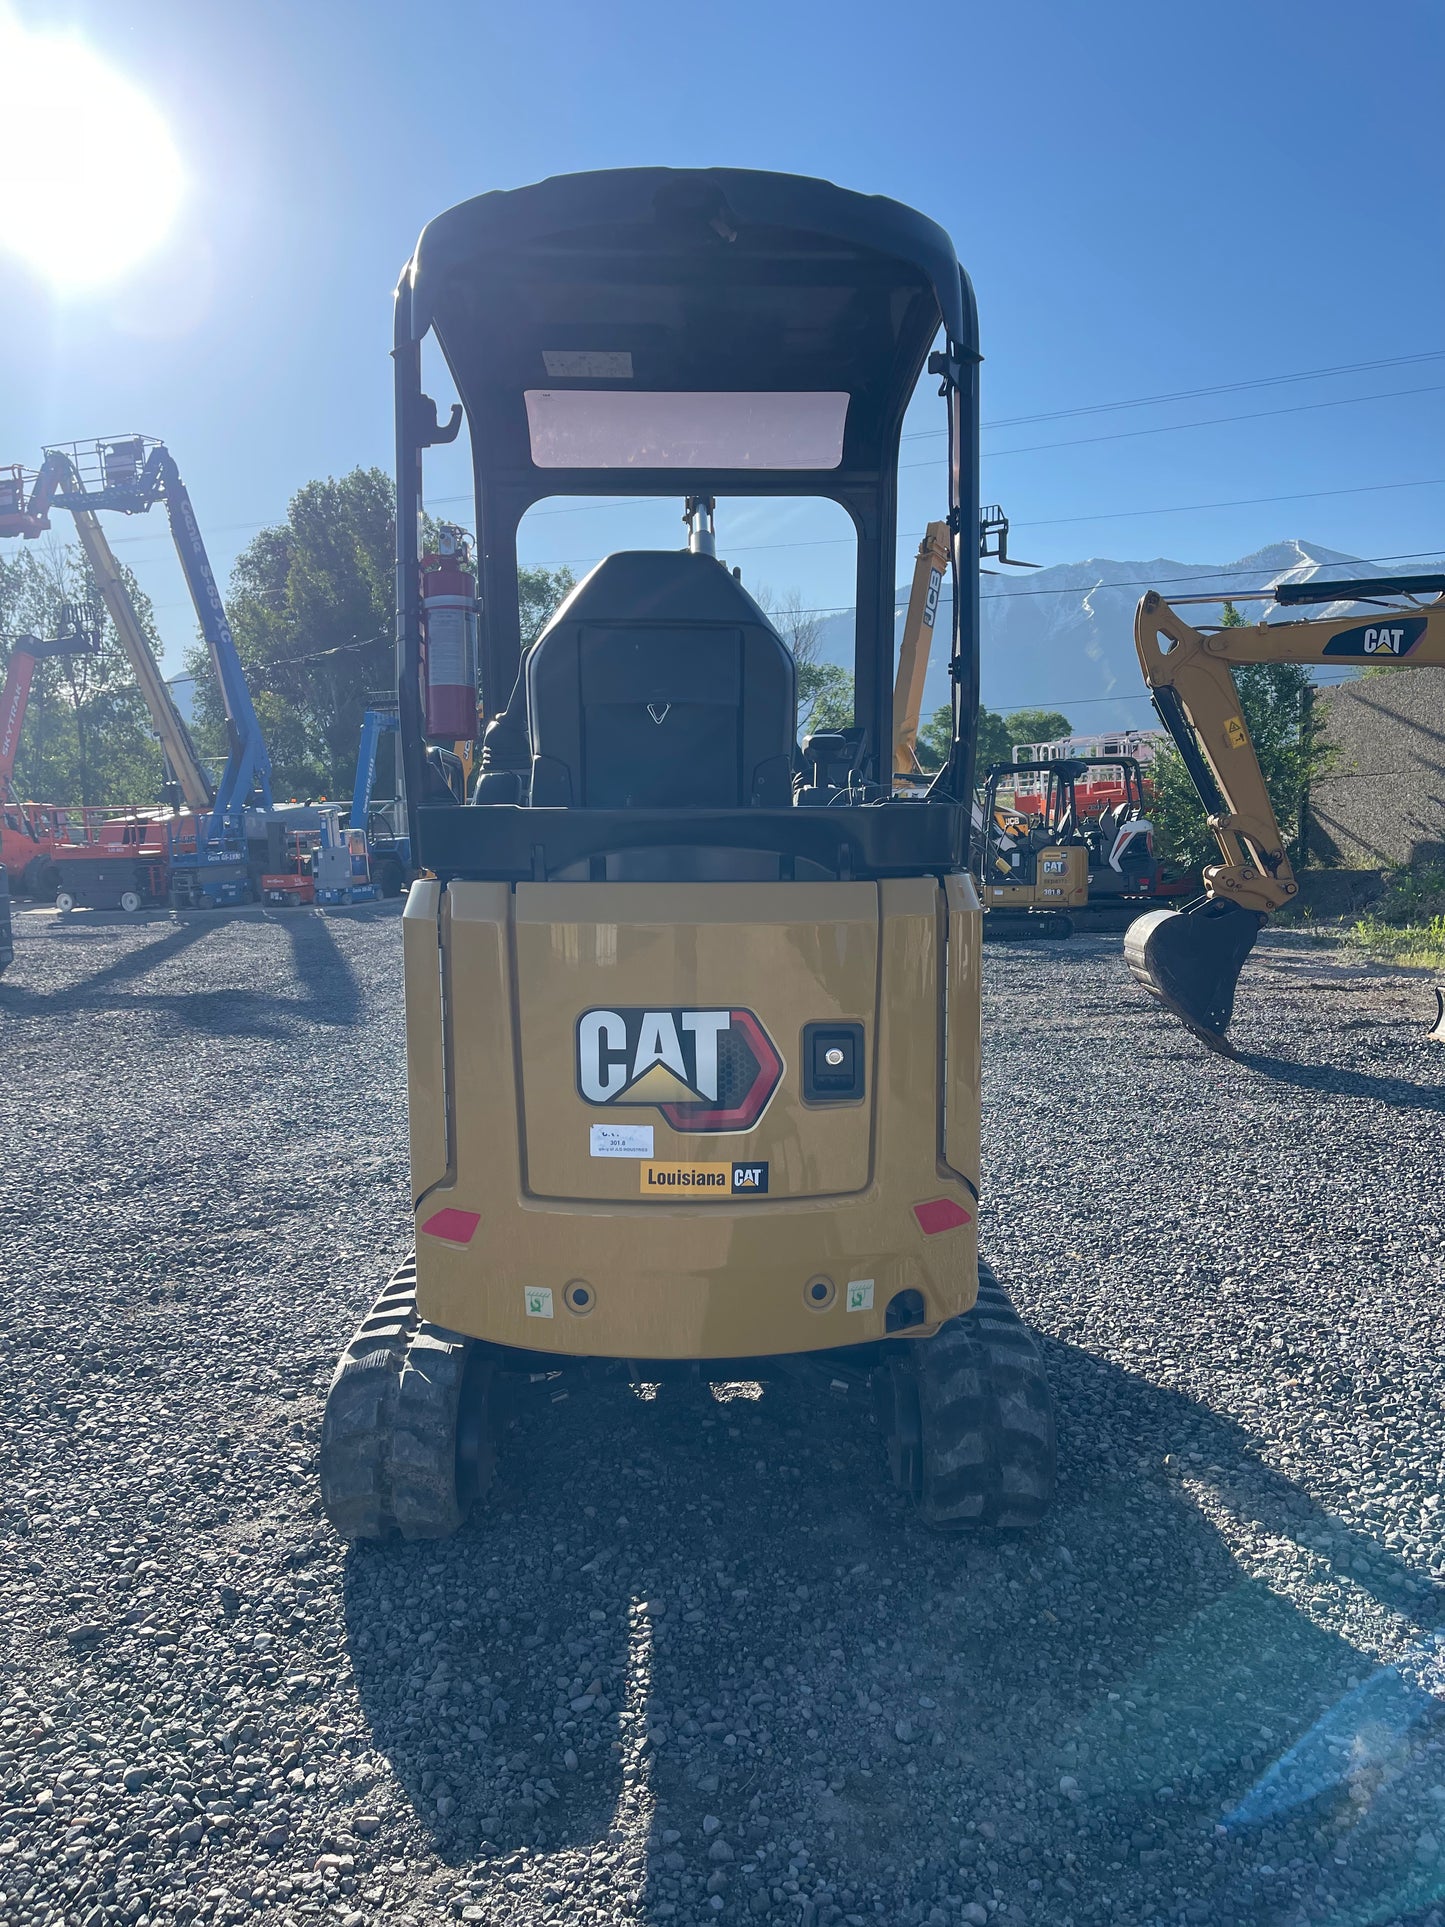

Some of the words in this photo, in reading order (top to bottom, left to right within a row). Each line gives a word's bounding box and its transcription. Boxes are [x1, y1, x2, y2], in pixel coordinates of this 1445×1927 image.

[924, 569, 941, 626] JCB
[1364, 628, 1404, 654] CAT
[2, 683, 21, 757] SKYTRAK
[1004, 817, 1019, 825] JCB
[1043, 861, 1063, 873] CAT
[580, 1010, 730, 1102] CAT
[648, 1168, 726, 1186] Louisiana
[734, 1169, 762, 1187] CAT
